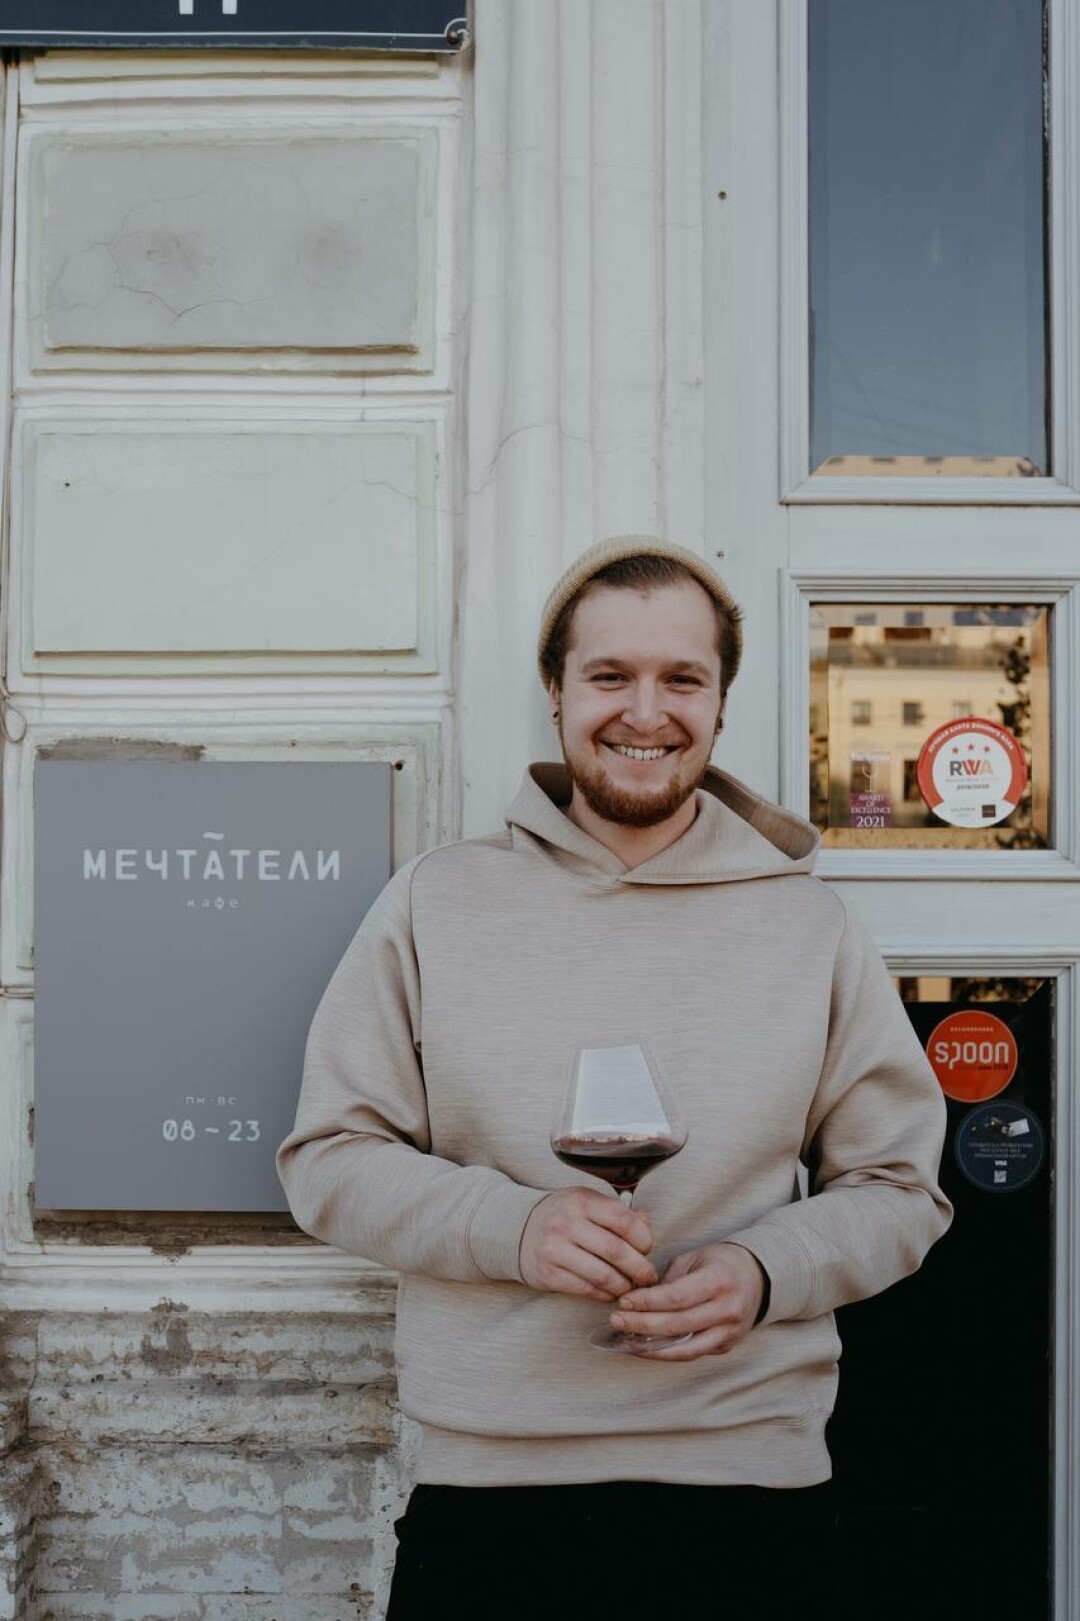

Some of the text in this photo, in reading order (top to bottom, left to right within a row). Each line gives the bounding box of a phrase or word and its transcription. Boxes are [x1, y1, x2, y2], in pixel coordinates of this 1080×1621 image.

[949, 758, 993, 776] RWA
[856, 816, 885, 828] 2021
[186, 896, 241, 910] кафе
[162, 1119, 196, 1142] 08
[227, 1119, 262, 1142] 23
